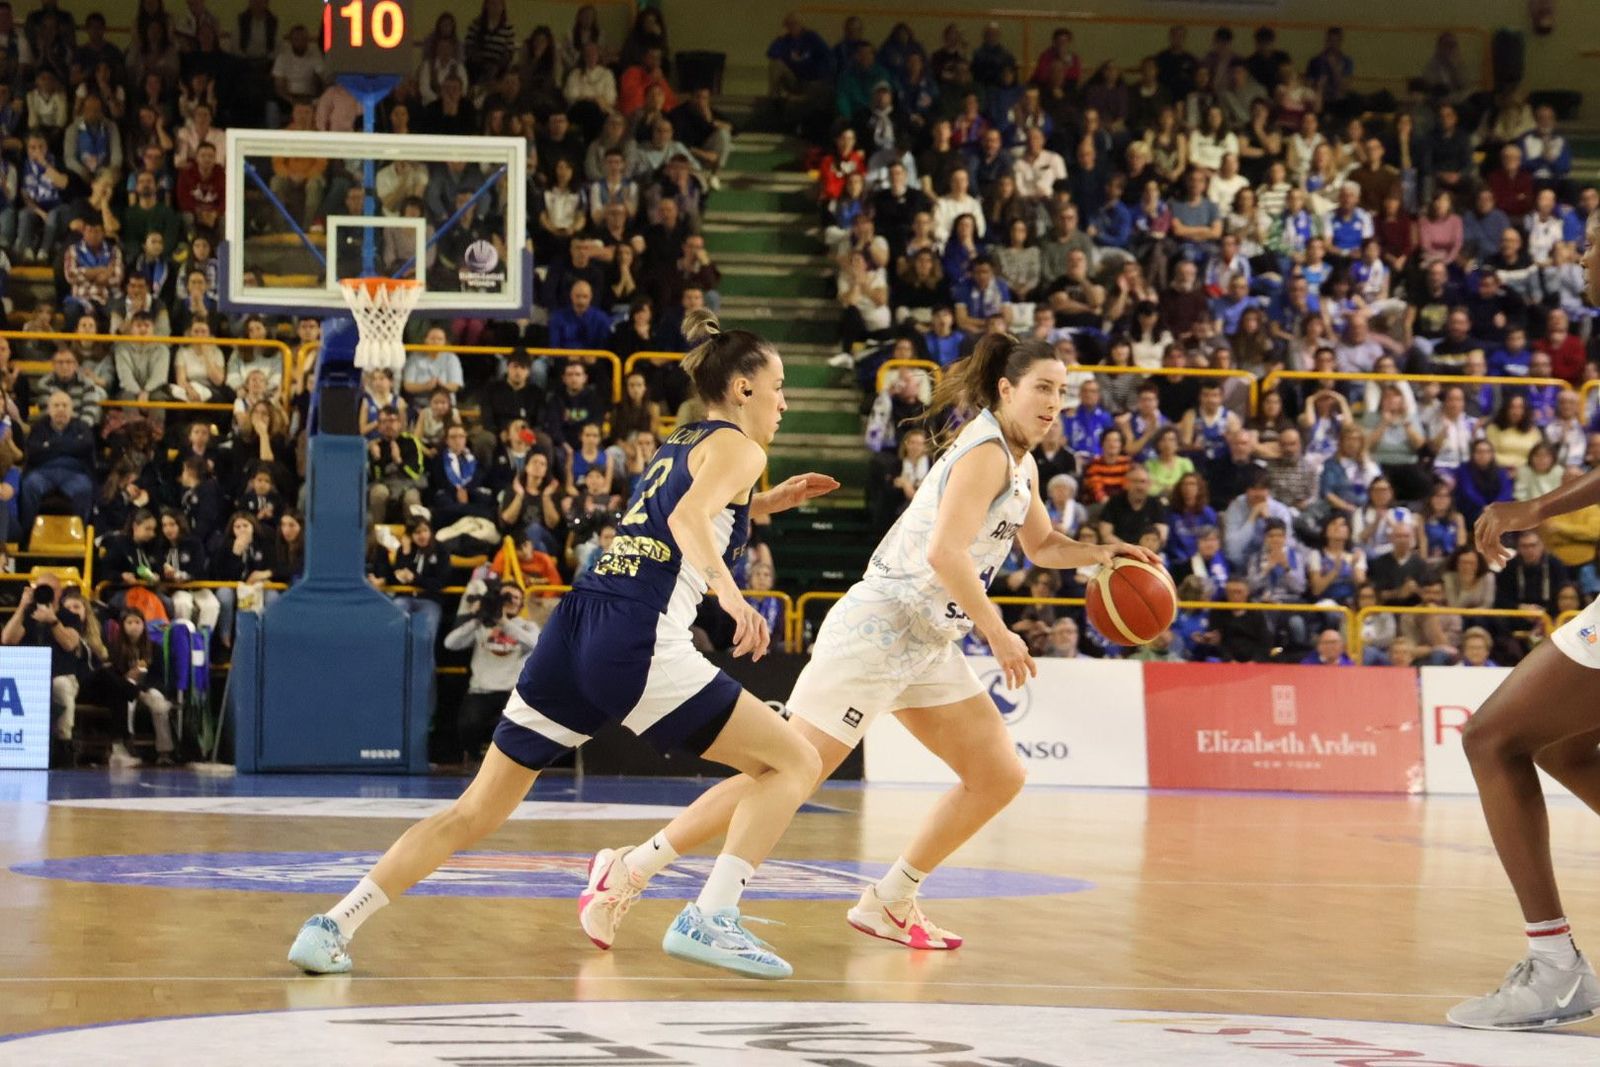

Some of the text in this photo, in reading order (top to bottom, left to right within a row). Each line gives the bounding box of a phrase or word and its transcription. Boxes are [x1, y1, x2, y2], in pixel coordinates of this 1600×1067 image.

[341, 0, 404, 49] 10
[622, 457, 674, 526] 2
[0, 677, 25, 716] A
[1016, 741, 1069, 760] NSO
[1197, 730, 1377, 755] Elizabeth Arden
